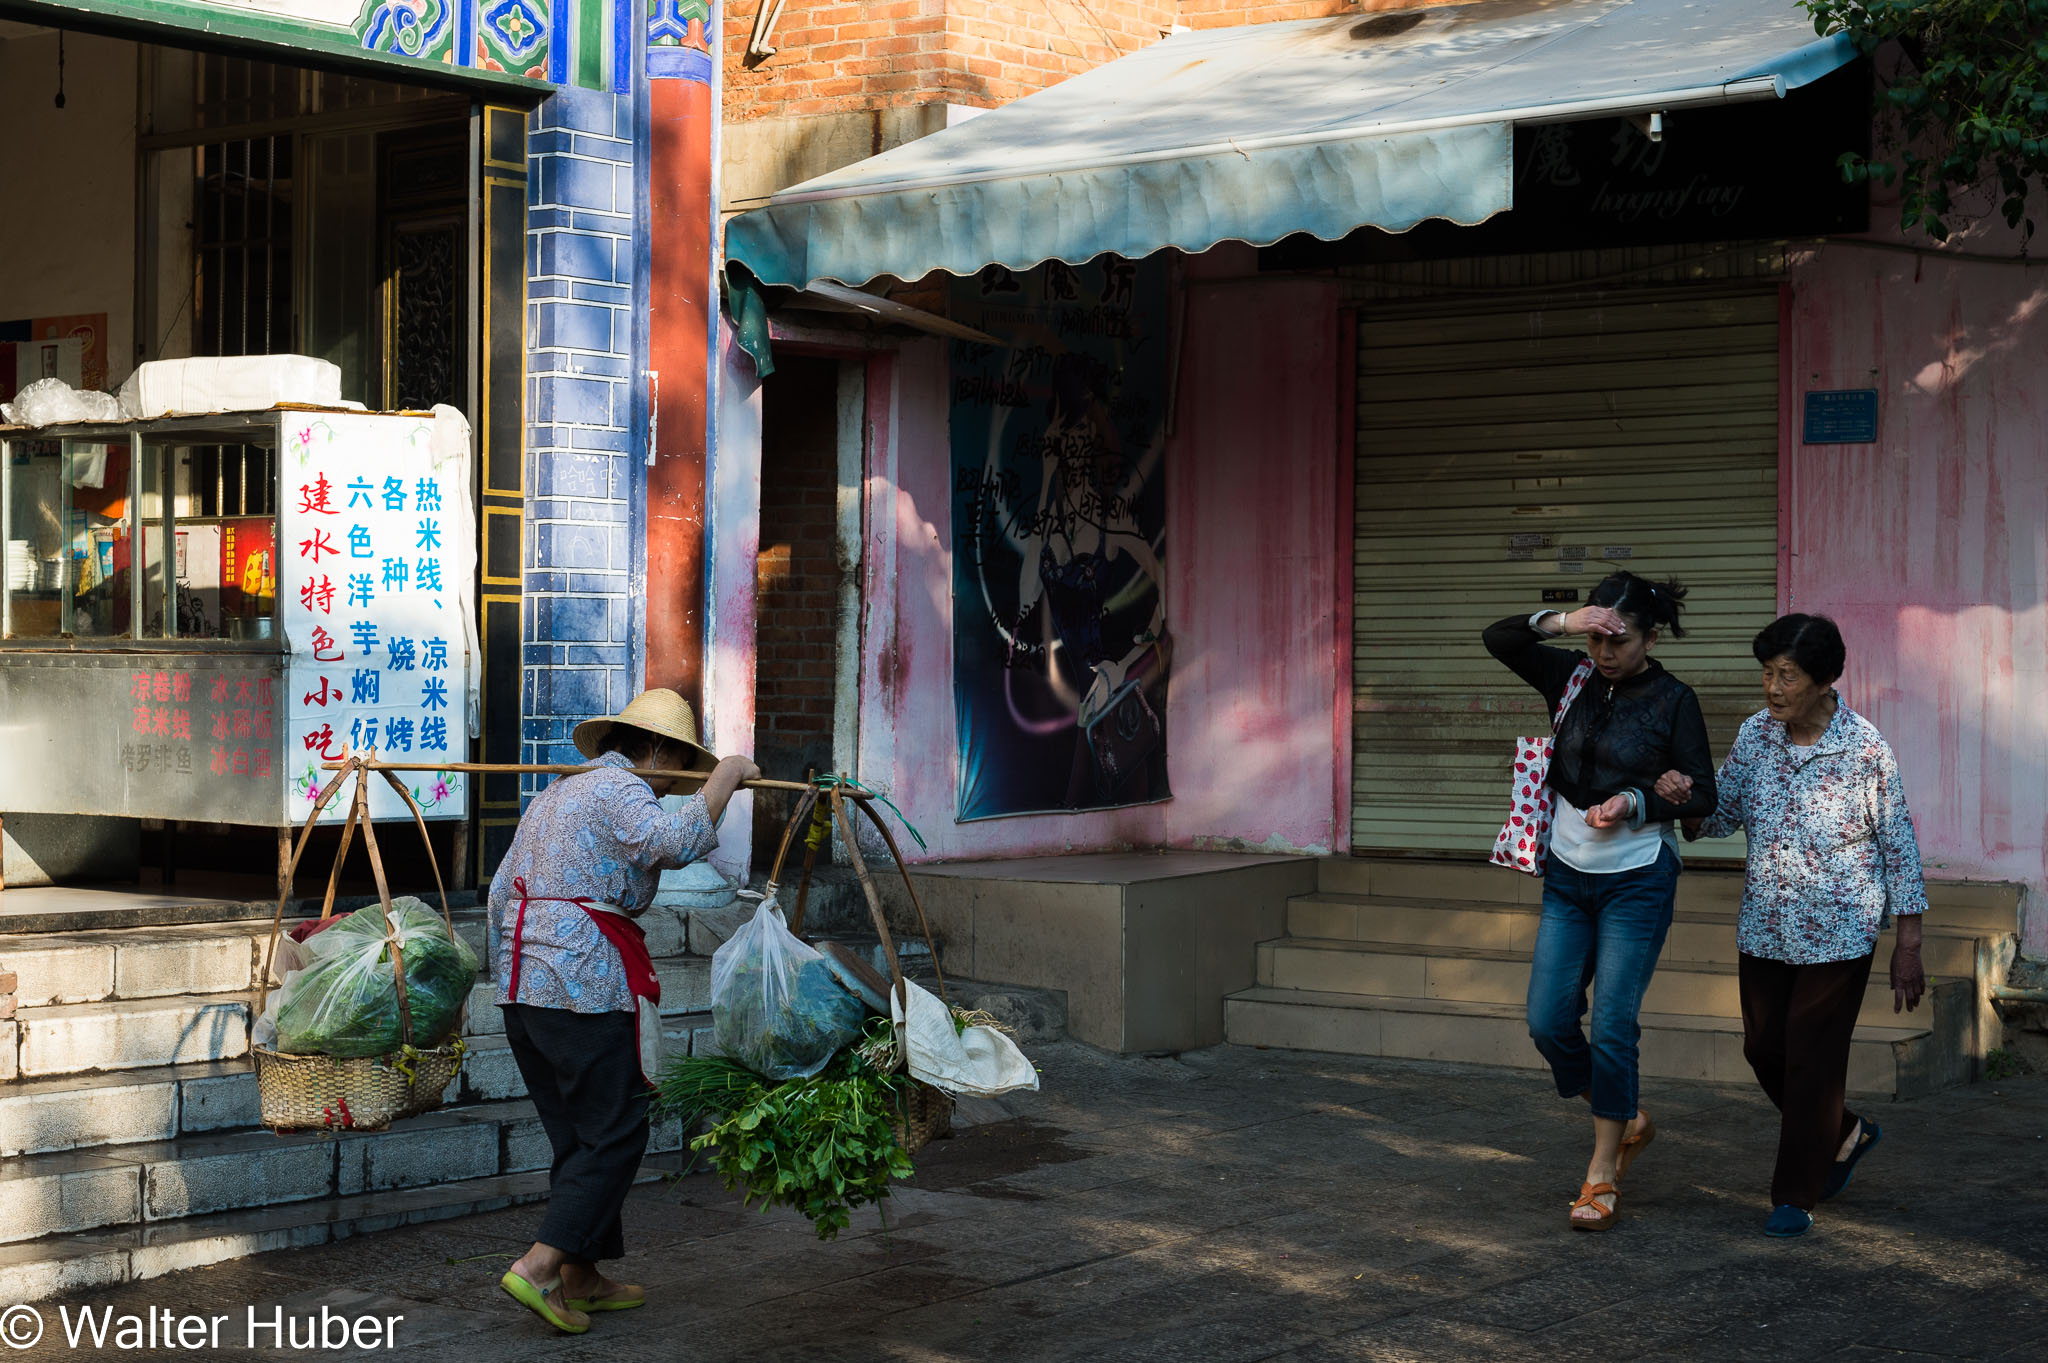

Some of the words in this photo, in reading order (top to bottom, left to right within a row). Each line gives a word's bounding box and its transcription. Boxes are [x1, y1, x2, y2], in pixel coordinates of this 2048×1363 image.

[298, 472, 345, 762] 建水特色小吃
[347, 476, 380, 751] 六色洋芋焖饭
[381, 476, 416, 752] 各种烧烤
[131, 671, 192, 703] 凉卷粉
[210, 673, 274, 706] 冰木瓜
[132, 705, 192, 741] 凉米线
[210, 743, 272, 778] 冰白酒
